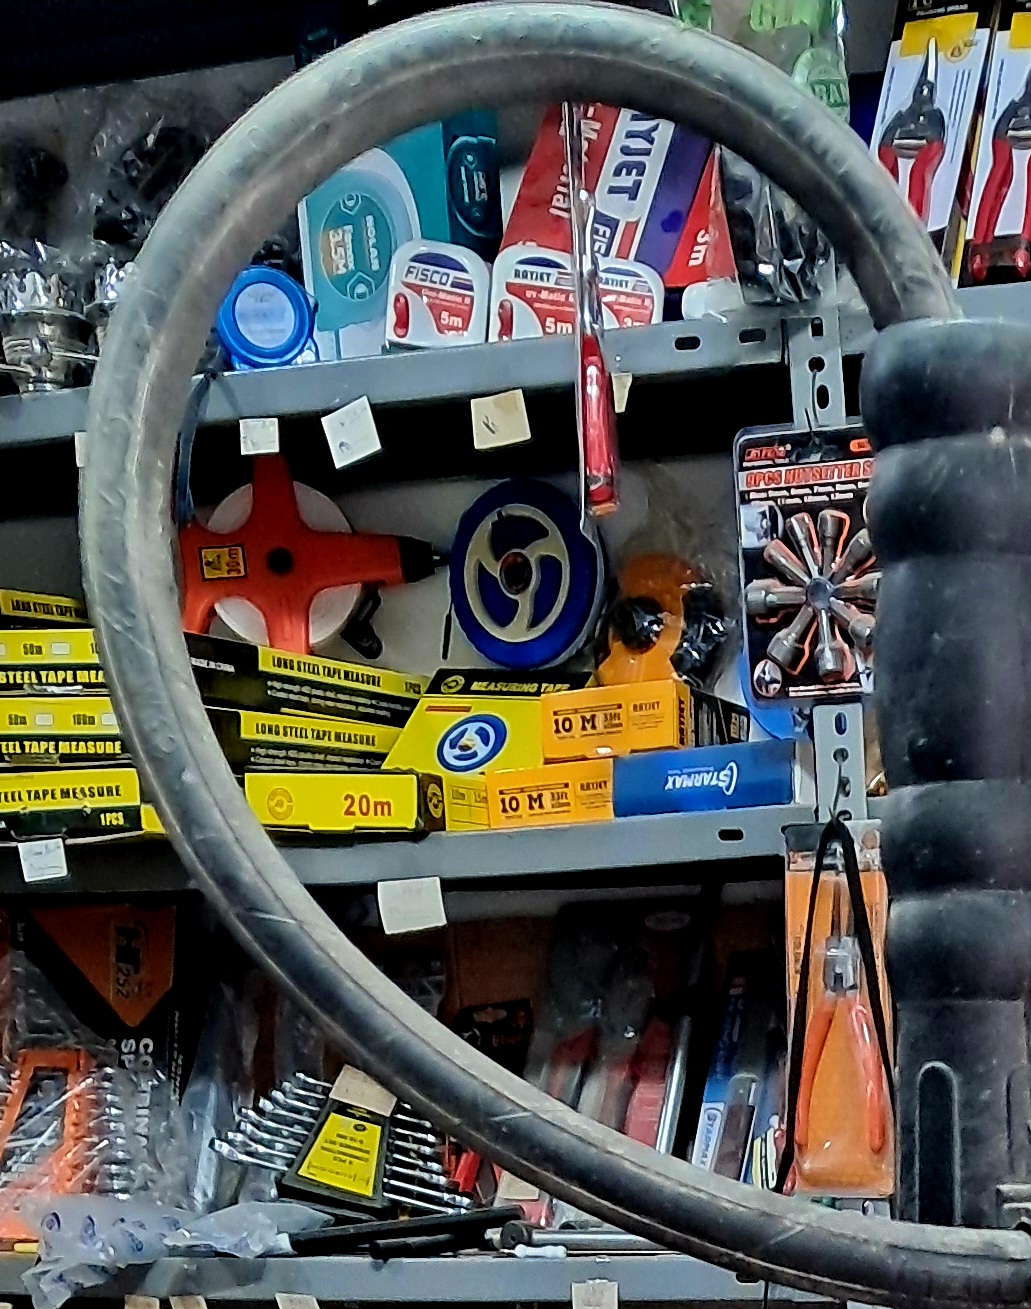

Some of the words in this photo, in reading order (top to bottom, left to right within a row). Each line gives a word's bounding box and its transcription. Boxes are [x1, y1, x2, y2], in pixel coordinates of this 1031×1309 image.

[404, 265, 451, 286] FISCO
[514, 268, 551, 283] RAYJET
[440, 310, 463, 328] 5m
[545, 317, 573, 334] 5m
[784, 461, 859, 485] NUTSETTER
[22, 642, 43, 656] 50m
[39, 671, 74, 684] TAPE
[271, 655, 294, 672] LONG
[296, 659, 321, 677] STEEL
[322, 663, 343, 680] TAPE
[343, 667, 381, 687] MEASURE
[469, 680, 539, 694] MEASURING
[632, 700, 661, 713] RAYJET
[553, 715, 572, 734] 10
[580, 713, 597, 732] M
[255, 722, 280, 736] LONG
[282, 725, 308, 740] STEEL
[310, 728, 333, 743] TAPE
[334, 732, 377, 747] MEASURE
[0, 741, 22, 754] EEL
[23, 741, 57, 754] TAPE
[59, 741, 122, 755] MEASURE
[579, 779, 609, 792] RAYJET
[664, 764, 735, 793] STARMAX
[26, 788, 53, 802] TAPE
[60, 785, 122, 800] MEASURE
[501, 794, 520, 812] 10
[527, 791, 545, 810] M
[343, 794, 392, 817] 20m
[100, 811, 125, 826] 1PCS
[114, 963, 131, 999] 252
